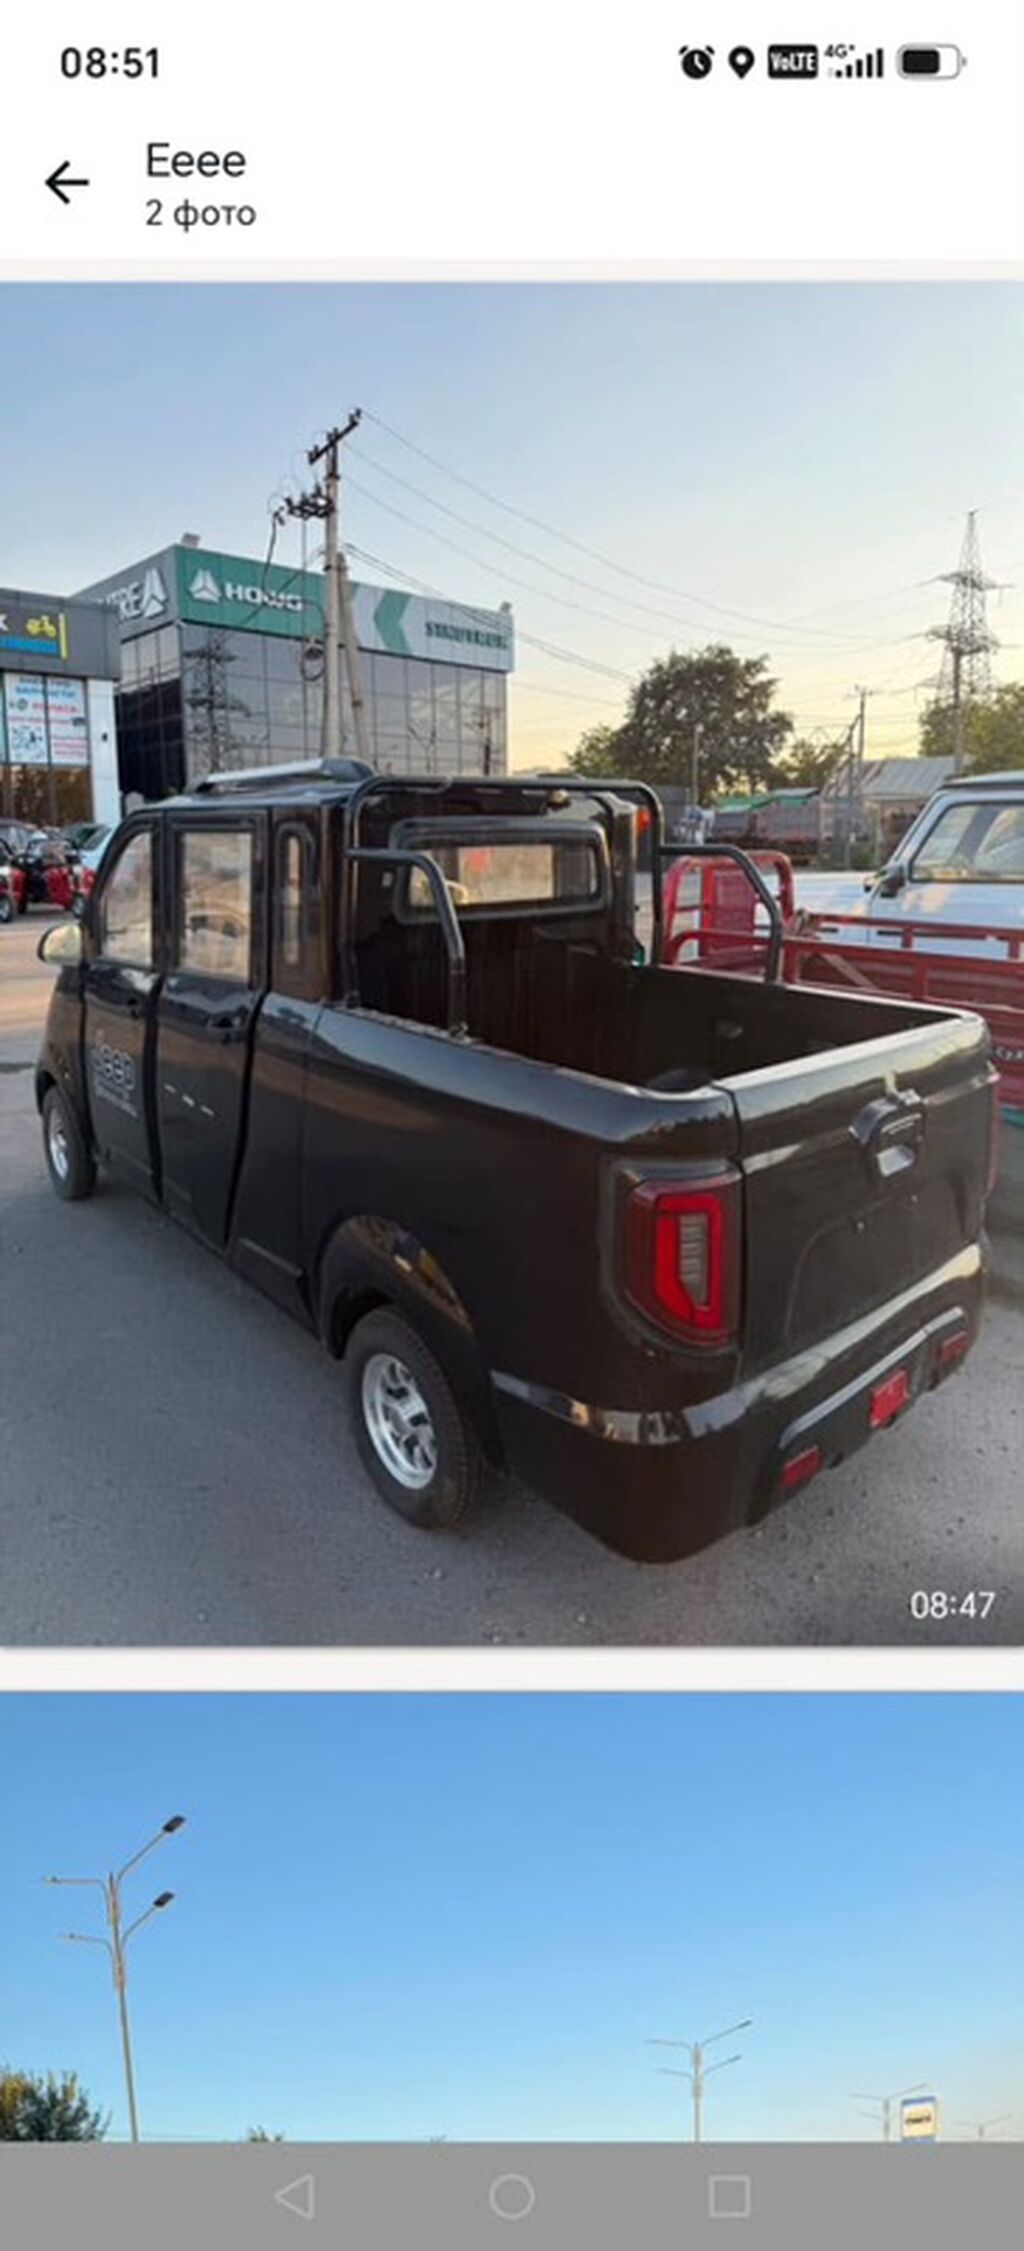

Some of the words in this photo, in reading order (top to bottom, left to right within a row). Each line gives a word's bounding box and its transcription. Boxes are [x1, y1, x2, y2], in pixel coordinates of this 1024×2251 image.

[61, 48, 158, 78] 08:51
[770, 53, 815, 71] VoLTE
[146, 200, 162, 223] 2
[174, 200, 256, 232] фото
